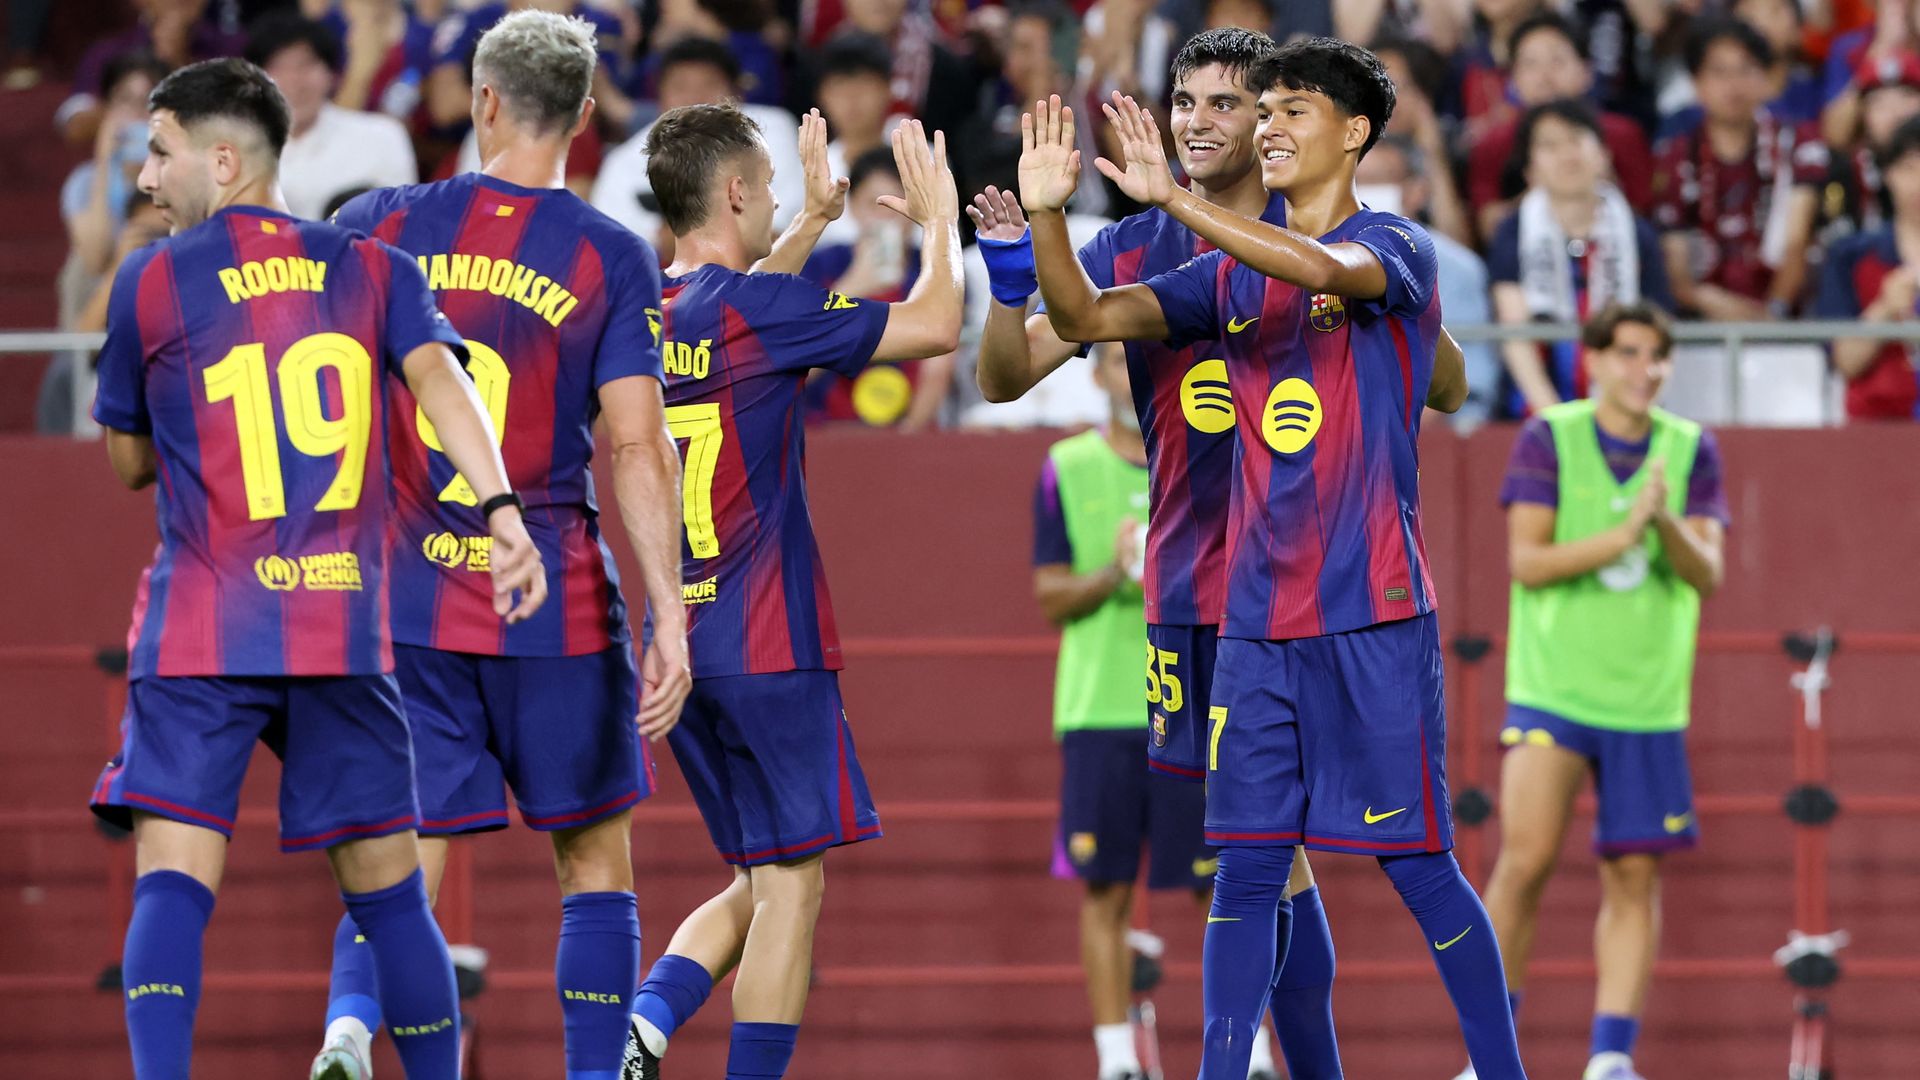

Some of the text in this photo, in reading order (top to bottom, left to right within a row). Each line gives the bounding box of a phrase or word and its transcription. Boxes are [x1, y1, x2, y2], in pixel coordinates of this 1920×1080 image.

[218, 256, 327, 304] ROONY
[203, 332, 372, 521] 19
[664, 402, 723, 559] 7
[1209, 706, 1228, 771] 7
